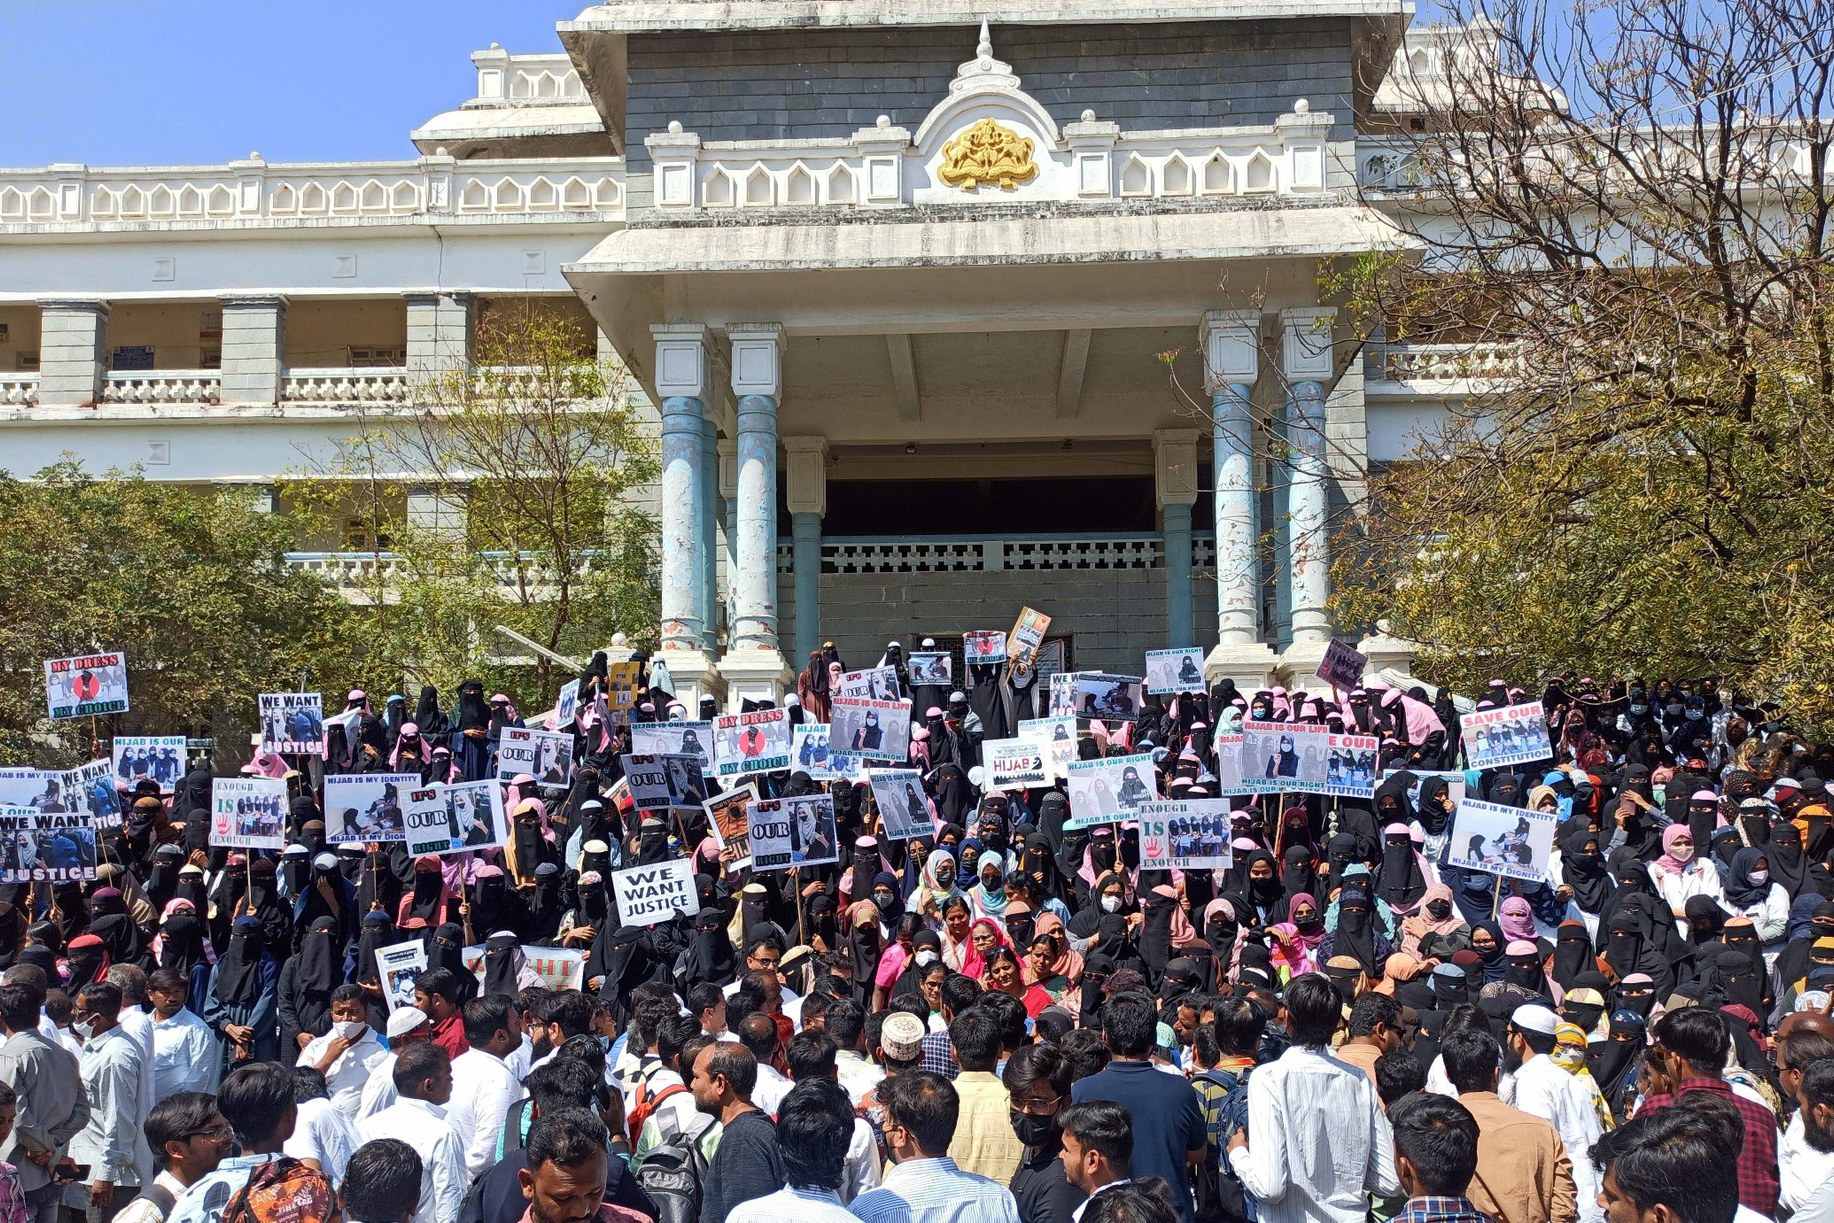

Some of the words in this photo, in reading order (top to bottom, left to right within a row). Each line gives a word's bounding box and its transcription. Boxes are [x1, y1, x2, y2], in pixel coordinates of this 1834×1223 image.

[51, 661, 70, 673] MY
[75, 655, 118, 669] DRESS
[1052, 675, 1068, 684] WE
[844, 685, 870, 698] OUR
[261, 696, 280, 708] WE
[283, 695, 319, 707] WANT
[833, 697, 859, 706] HIJAB
[872, 701, 890, 709] OUR
[53, 706, 73, 718] MY
[75, 700, 125, 715] CHOICE
[1463, 711, 1504, 727] SAVE
[1508, 705, 1542, 718] OUR
[719, 716, 738, 728] MY
[741, 710, 784, 725] DRESS
[796, 725, 827, 733] HIJAB
[1244, 722, 1273, 731] HIJAB
[1275, 723, 1285, 731] IS
[1287, 724, 1306, 732] OUR
[1308, 725, 1328, 734] LIFE
[115, 738, 146, 746] HIJAB
[150, 738, 160, 746] IS
[163, 738, 184, 746] OUR
[510, 730, 531, 741] IT'S
[1220, 735, 1244, 743] HIJA
[263, 741, 323, 753] JUSTICE
[1342, 738, 1377, 749] OUR
[502, 747, 534, 762] OUR
[631, 755, 654, 765] IT'S
[829, 749, 853, 757] HIJAB
[882, 753, 906, 761] RIGHT
[1470, 749, 1551, 769] CONSTITUTION
[720, 763, 738, 775] MY
[741, 756, 789, 772] CHOICE
[994, 758, 1030, 772] HIJAB
[1068, 761, 1094, 771] HIJAB
[1095, 760, 1105, 768] IS
[1107, 758, 1124, 766] OUR
[1126, 755, 1151, 764] RIGHT
[61, 772, 79, 787] WE
[81, 763, 110, 779] WANT
[630, 773, 666, 786] OUR
[216, 782, 254, 791] ENOUGH
[410, 789, 436, 802] IT'S
[637, 797, 670, 807] RIGHT
[218, 798, 234, 813] IS
[757, 800, 781, 812] IT'S
[1141, 803, 1188, 814] ENOUGH
[1462, 800, 1487, 810] HIJAB
[1500, 807, 1513, 815] MY
[0, 816, 29, 830] WE
[34, 815, 91, 829] WANT
[96, 812, 122, 830] TICE
[407, 810, 447, 829] OUR
[1075, 816, 1100, 825] HIJAB
[1102, 815, 1111, 823] IS
[752, 821, 790, 840] OUR
[1143, 821, 1165, 837] IS
[214, 836, 251, 845] ENOUGH
[412, 839, 450, 855] RIGHT
[755, 853, 791, 867] RIGHT
[1143, 857, 1190, 868] ENOUGH
[1452, 857, 1477, 867] HIJAB
[1490, 864, 1504, 873] MY
[2, 867, 94, 882] JUSTICE
[625, 867, 674, 886] WE
[623, 880, 685, 901] WANT
[627, 895, 689, 917] JUSTICE
